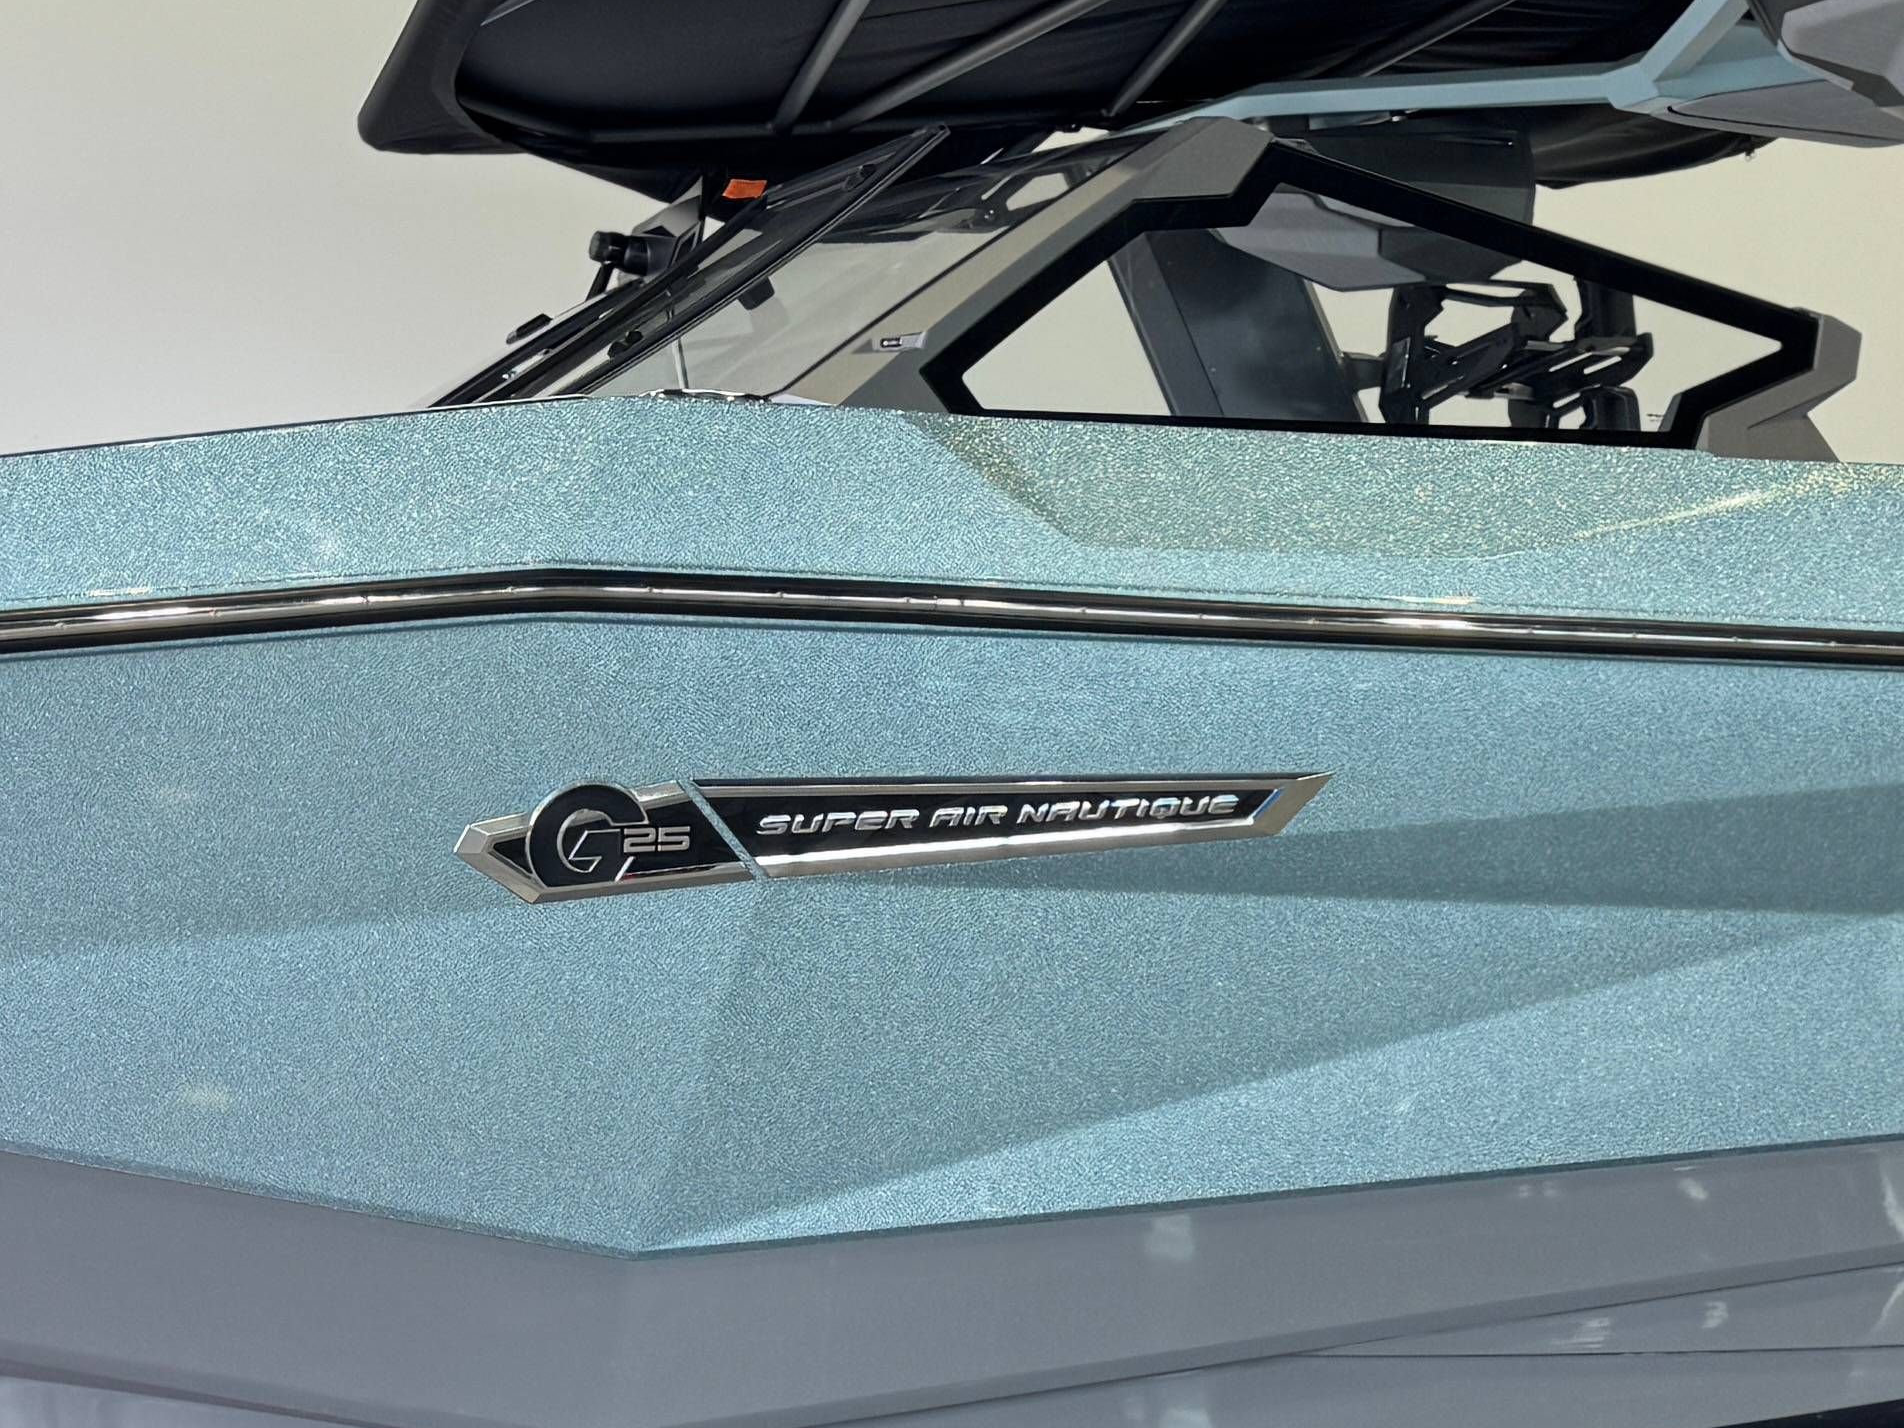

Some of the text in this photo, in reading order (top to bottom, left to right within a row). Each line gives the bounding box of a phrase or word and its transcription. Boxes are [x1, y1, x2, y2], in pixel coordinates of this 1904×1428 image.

[756, 808, 920, 835] SUPER
[929, 804, 1008, 828] AIR
[1016, 794, 1239, 824] NAUTIQUE
